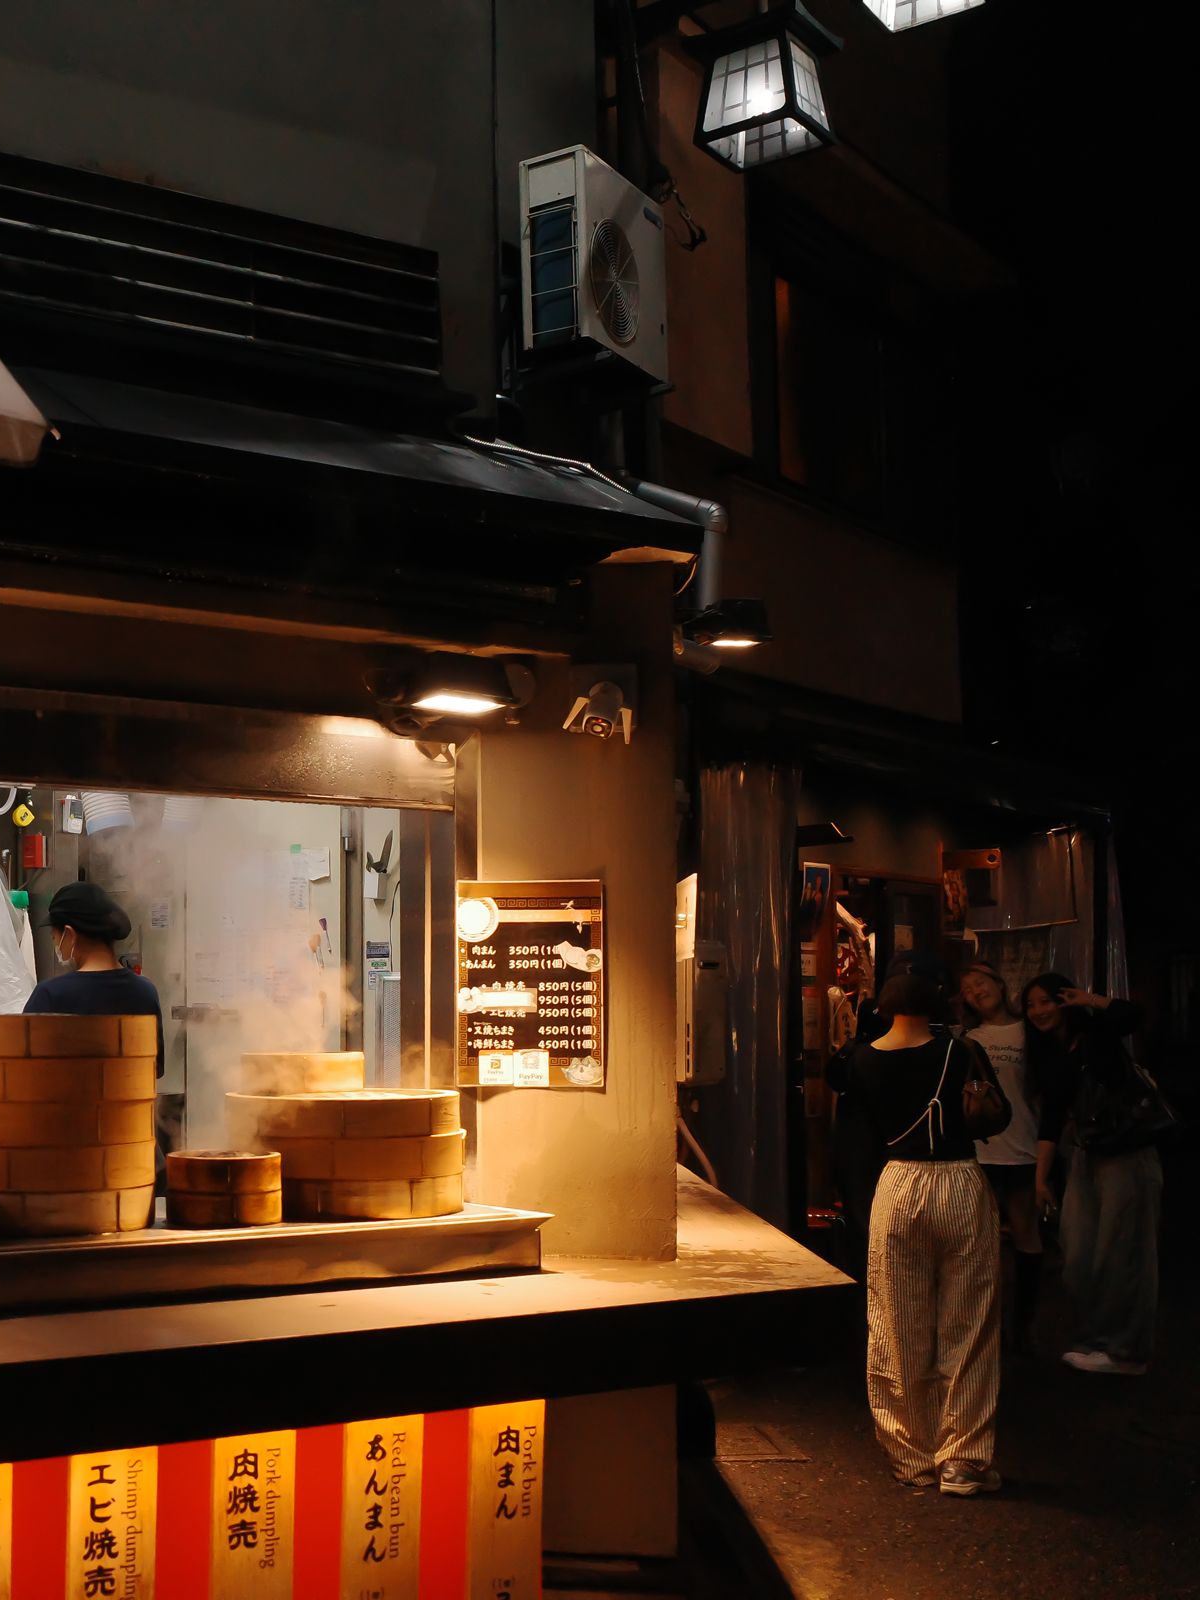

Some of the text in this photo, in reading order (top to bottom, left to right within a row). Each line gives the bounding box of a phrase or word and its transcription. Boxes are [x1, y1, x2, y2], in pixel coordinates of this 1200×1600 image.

[466, 960, 496, 969] あんまん
[121, 1459, 143, 1520] Shrimp
[227, 1448, 261, 1550] 肉焼売
[259, 1447, 282, 1570] Pork dumpling
[363, 1434, 388, 1562] あんまん
[389, 1431, 406, 1559] Red bean bun
[493, 1425, 520, 1520] 肉まん
[521, 1425, 537, 1517] Pork bun
[82, 1464, 120, 1598] エビ焼売
